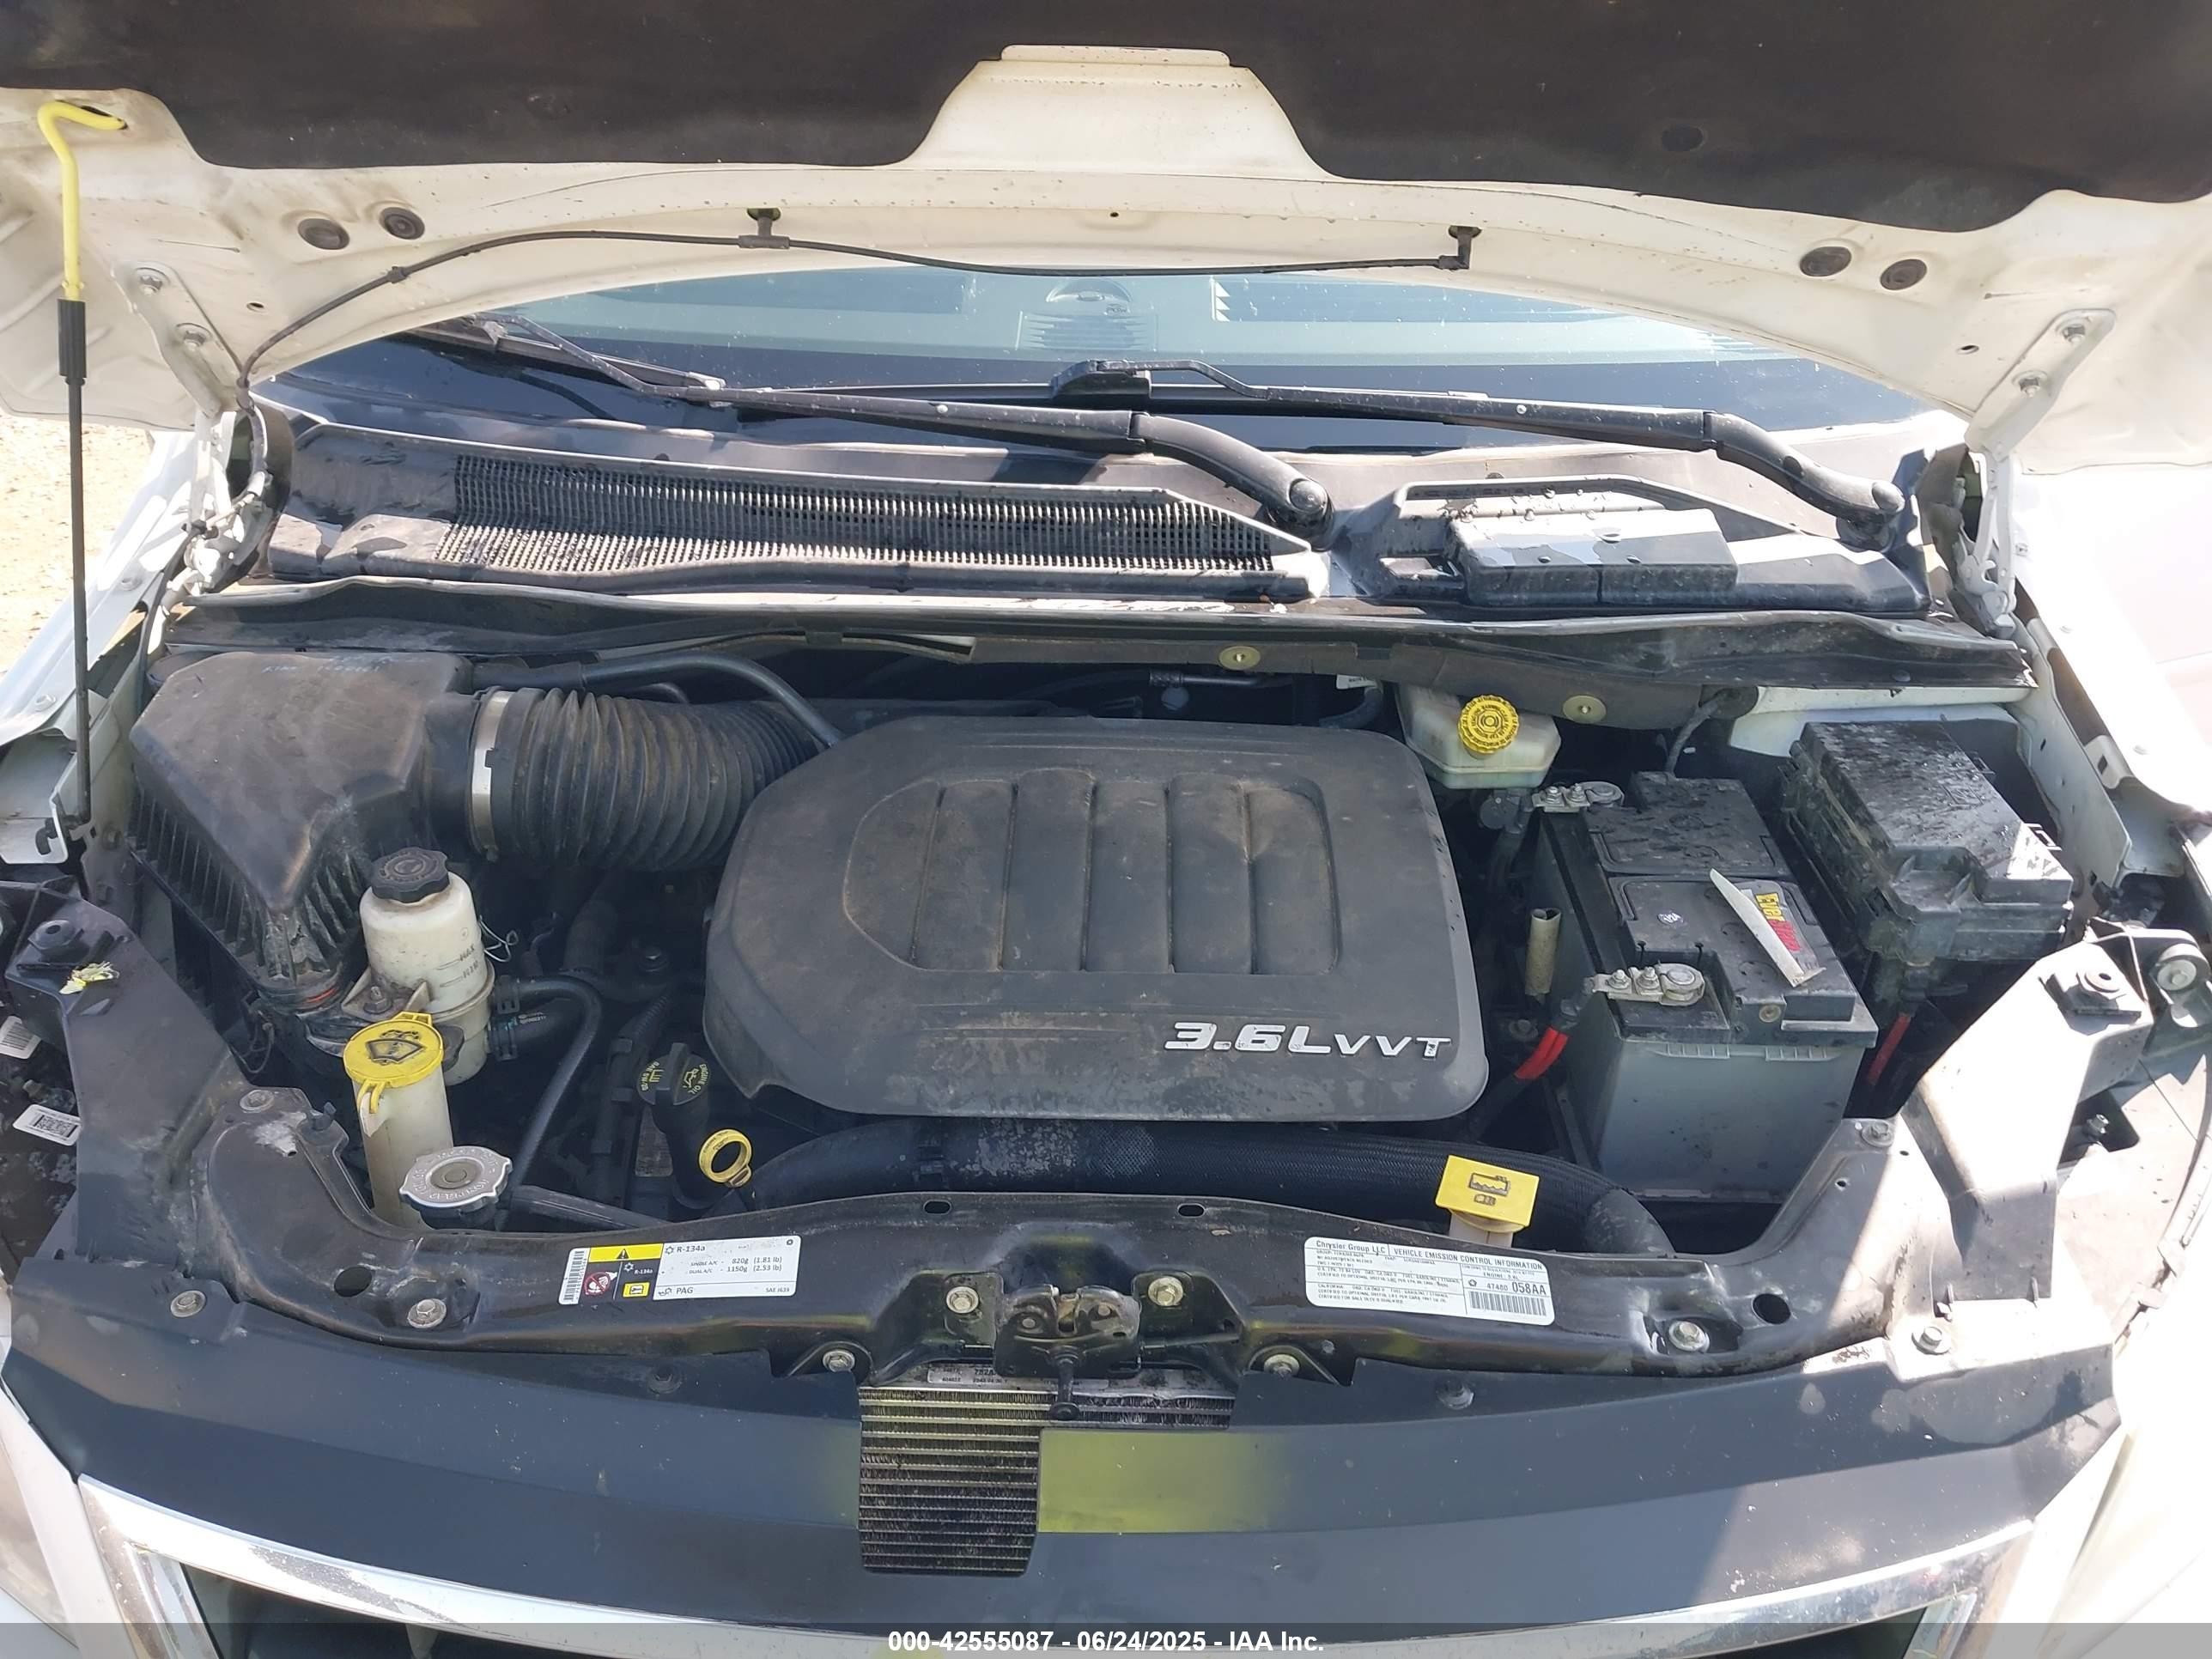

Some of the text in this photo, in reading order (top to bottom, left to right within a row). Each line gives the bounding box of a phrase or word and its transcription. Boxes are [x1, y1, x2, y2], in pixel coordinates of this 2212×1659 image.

[1164, 1022, 1333, 1056] 3.6L
[688, 1063, 710, 1095] ENGINE OIL
[1316, 1240, 1346, 1250] Chrysler
[1348, 1243, 1370, 1253] Group
[1394, 1248, 1423, 1258] VEHICLE
[1425, 1252, 1458, 1261] EMISSION
[1460, 1255, 1492, 1266] CONTROL
[1494, 1258, 1543, 1270] INFORMATION
[1512, 1281, 1547, 1295] 058AA
